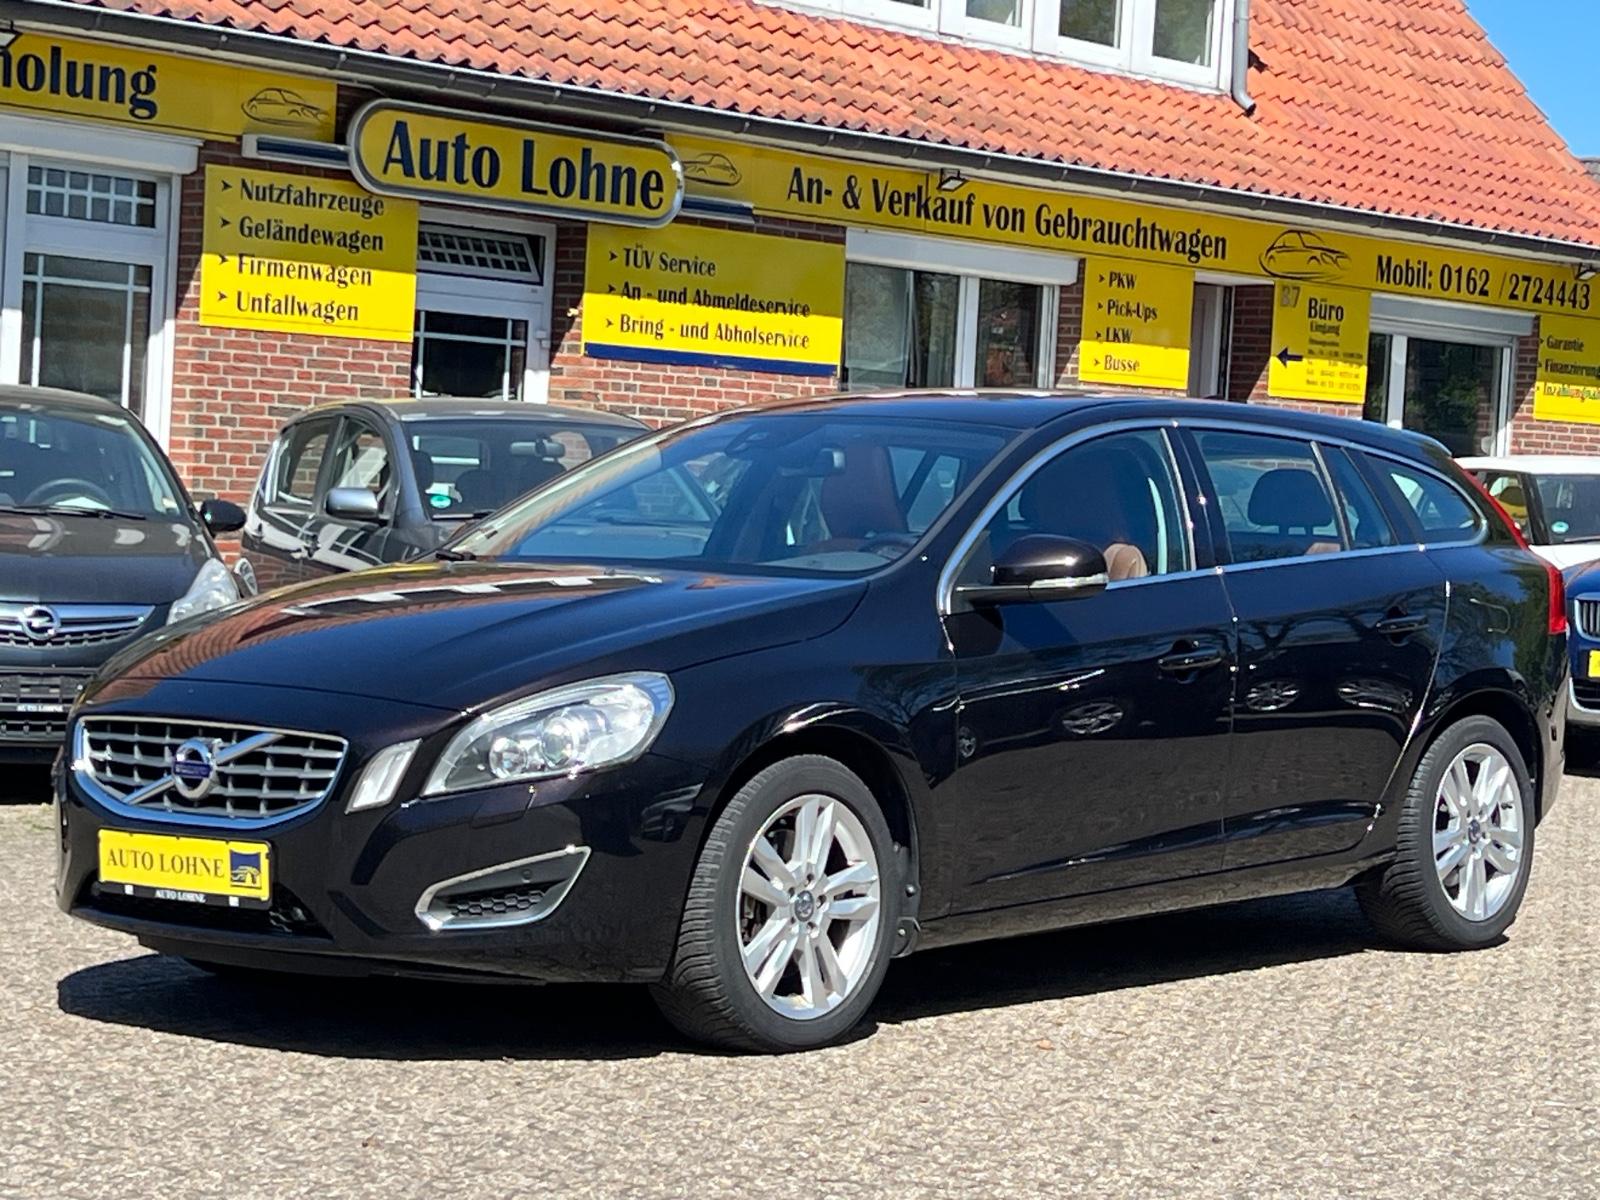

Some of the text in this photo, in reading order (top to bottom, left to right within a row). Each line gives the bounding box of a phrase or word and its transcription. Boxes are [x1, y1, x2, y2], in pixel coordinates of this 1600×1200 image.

[383, 119, 664, 210] Auto Lohne
[240, 178, 385, 219] Nutzfahrzeuge
[786, 166, 1228, 264] An- & Verkauf von Gebrauchtwagen
[239, 215, 384, 254] Geländewagen
[237, 252, 372, 289] Firmenwagen
[623, 243, 716, 277] TÜV Service
[1375, 254, 1432, 291] Mobil:
[1438, 263, 1490, 298] 0162
[1108, 271, 1137, 290] PKW
[236, 290, 359, 325] Unfallwagen
[620, 280, 641, 301] An
[657, 286, 687, 305] und
[691, 287, 811, 318] Abmeldeservice
[1107, 299, 1158, 323] Pick-Ups
[1307, 296, 1345, 322] Büro
[619, 312, 664, 341] Bring
[680, 322, 709, 341] und
[713, 322, 810, 350] Abholservice
[1105, 326, 1132, 344] LKW
[1546, 334, 1585, 352] Garantie
[1103, 354, 1140, 372] Busse
[106, 848, 226, 880] AUTO LOHNE
